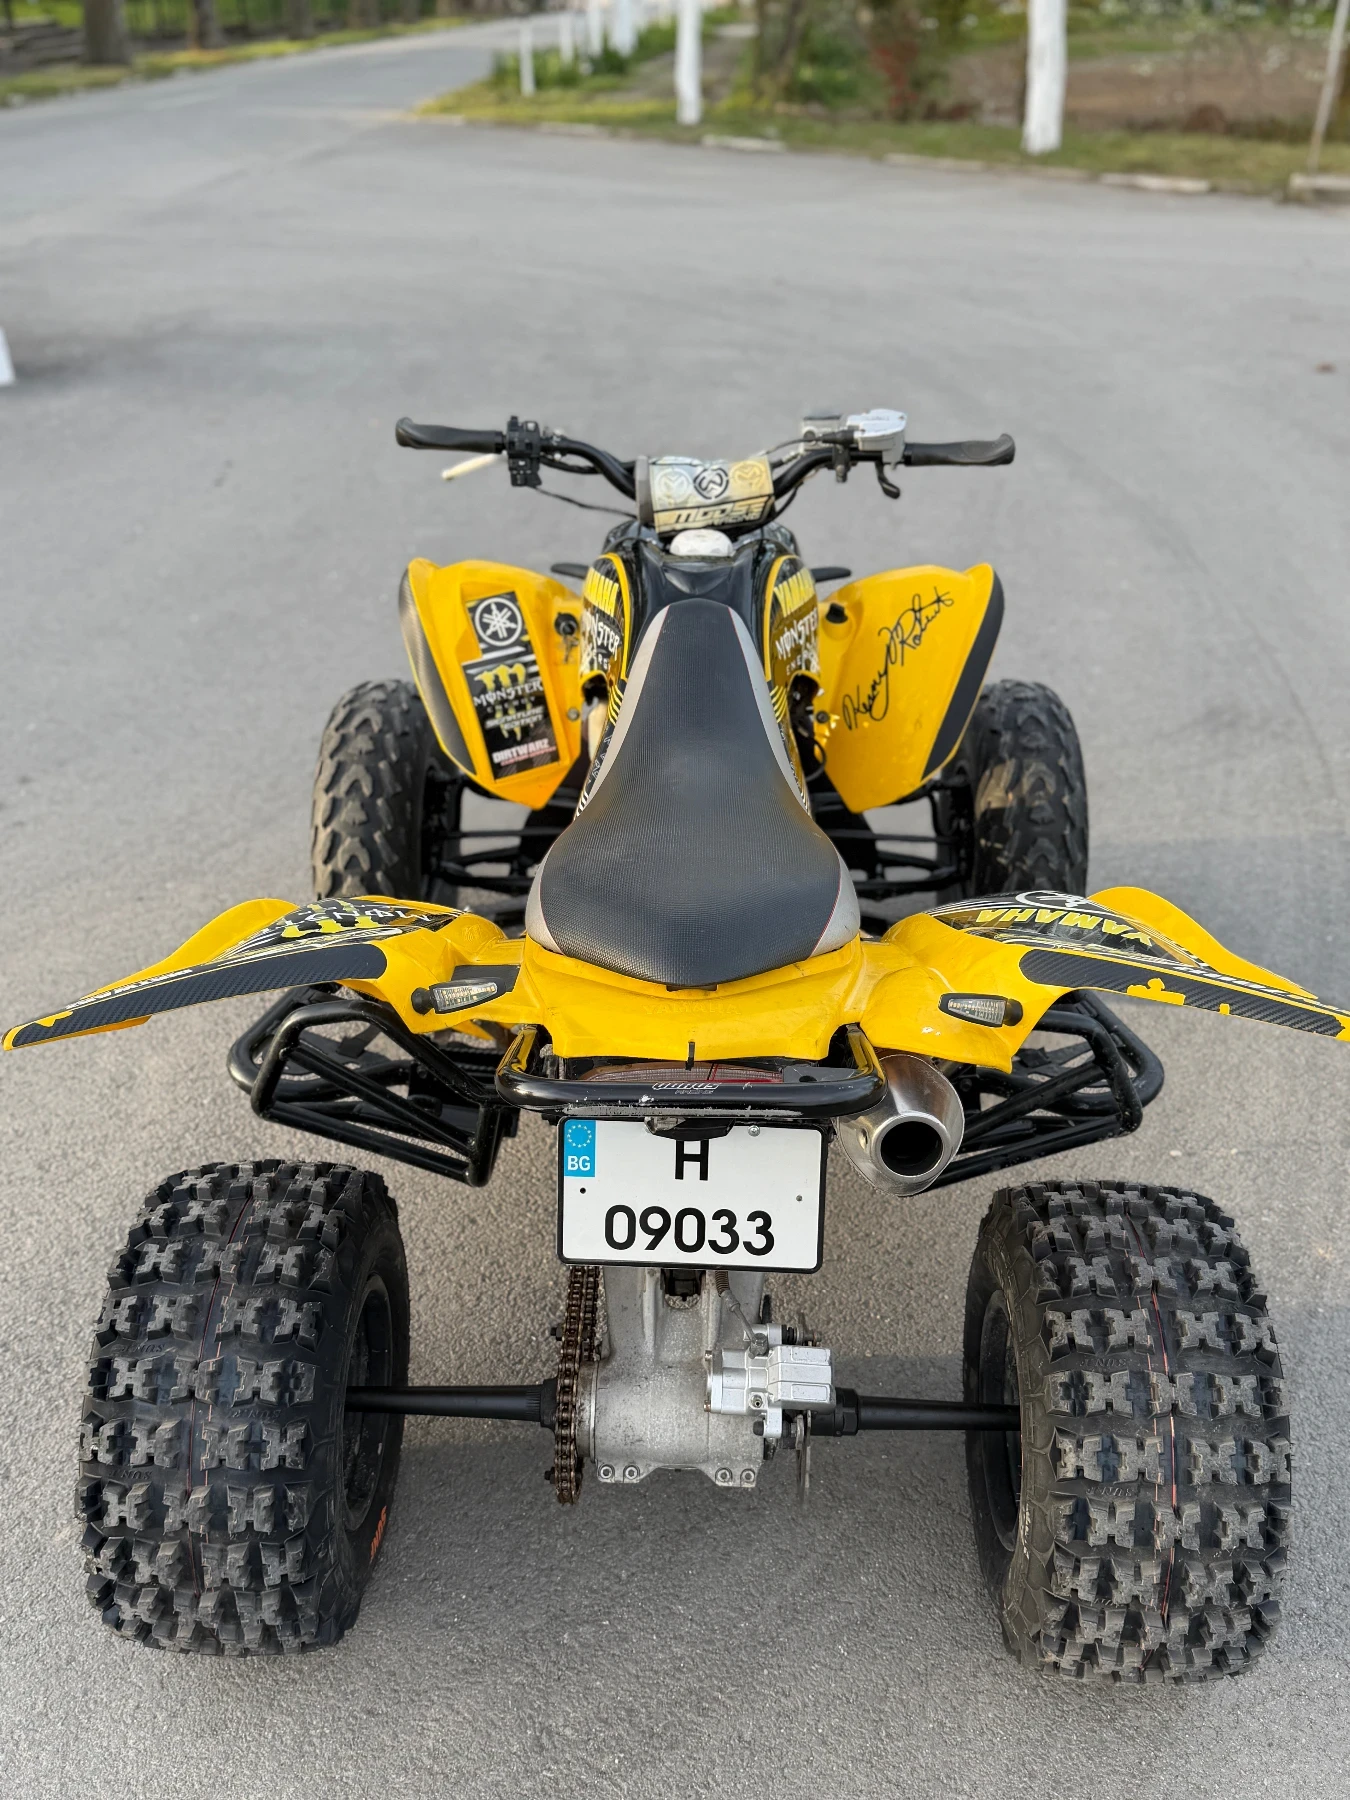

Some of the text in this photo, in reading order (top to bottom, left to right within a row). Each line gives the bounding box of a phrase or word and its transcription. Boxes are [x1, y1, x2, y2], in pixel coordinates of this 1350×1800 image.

[473, 680, 543, 706] MONSTER
[492, 738, 550, 764] DIRTWARZ
[976, 908, 1153, 947] YAMAHA
[567, 1155, 591, 1171] BG
[675, 1139, 709, 1181] H
[604, 1204, 775, 1256] 09033
